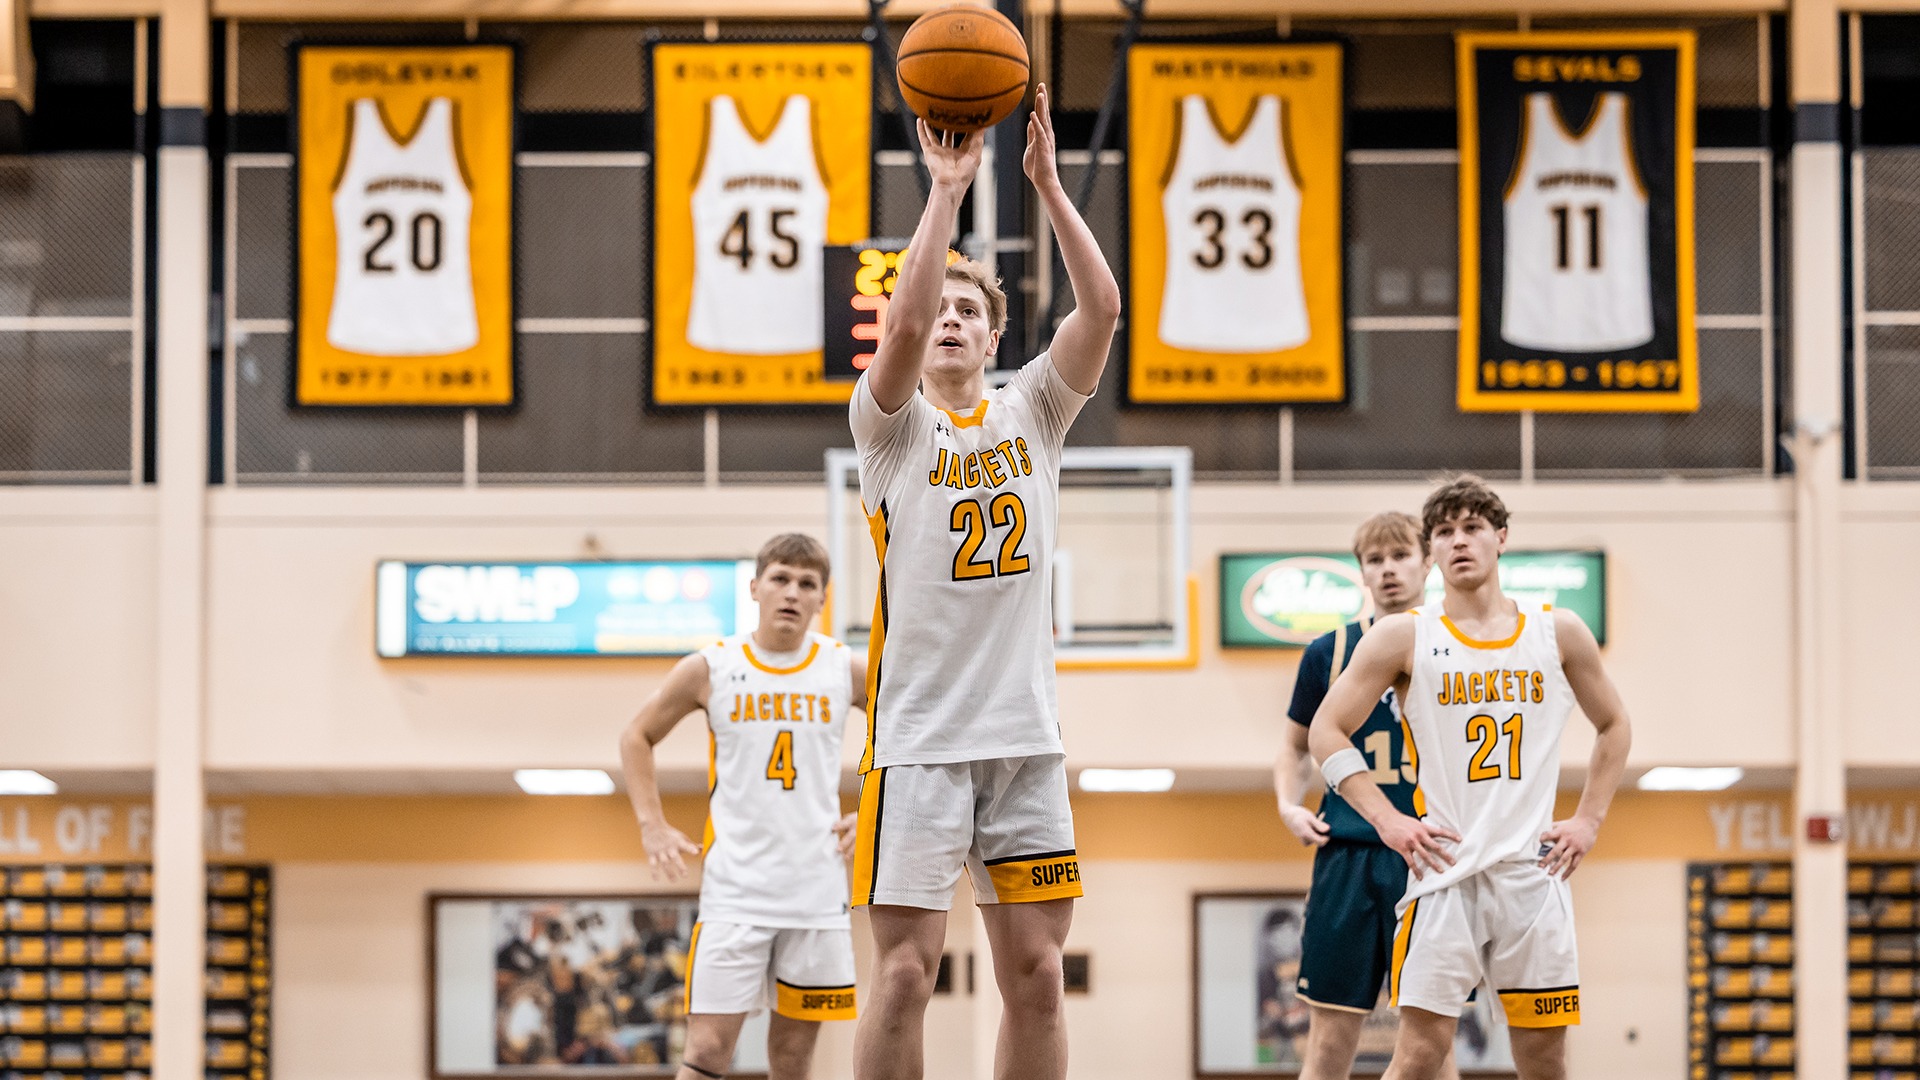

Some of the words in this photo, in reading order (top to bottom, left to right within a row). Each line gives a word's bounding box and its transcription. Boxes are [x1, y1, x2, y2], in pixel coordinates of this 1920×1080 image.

[1513, 55, 1642, 82] SEVALS
[364, 212, 443, 272] 20
[719, 209, 799, 270] 45
[1194, 208, 1274, 270] 33
[1551, 205, 1600, 269] 11
[949, 491, 1031, 582] 22
[730, 692, 832, 724] JACKETS
[1437, 669, 1544, 706] JACKETS
[766, 728, 797, 791] 4
[1465, 712, 1524, 783] 21
[55, 804, 113, 855] OF
[1534, 995, 1579, 1015] SUPER
